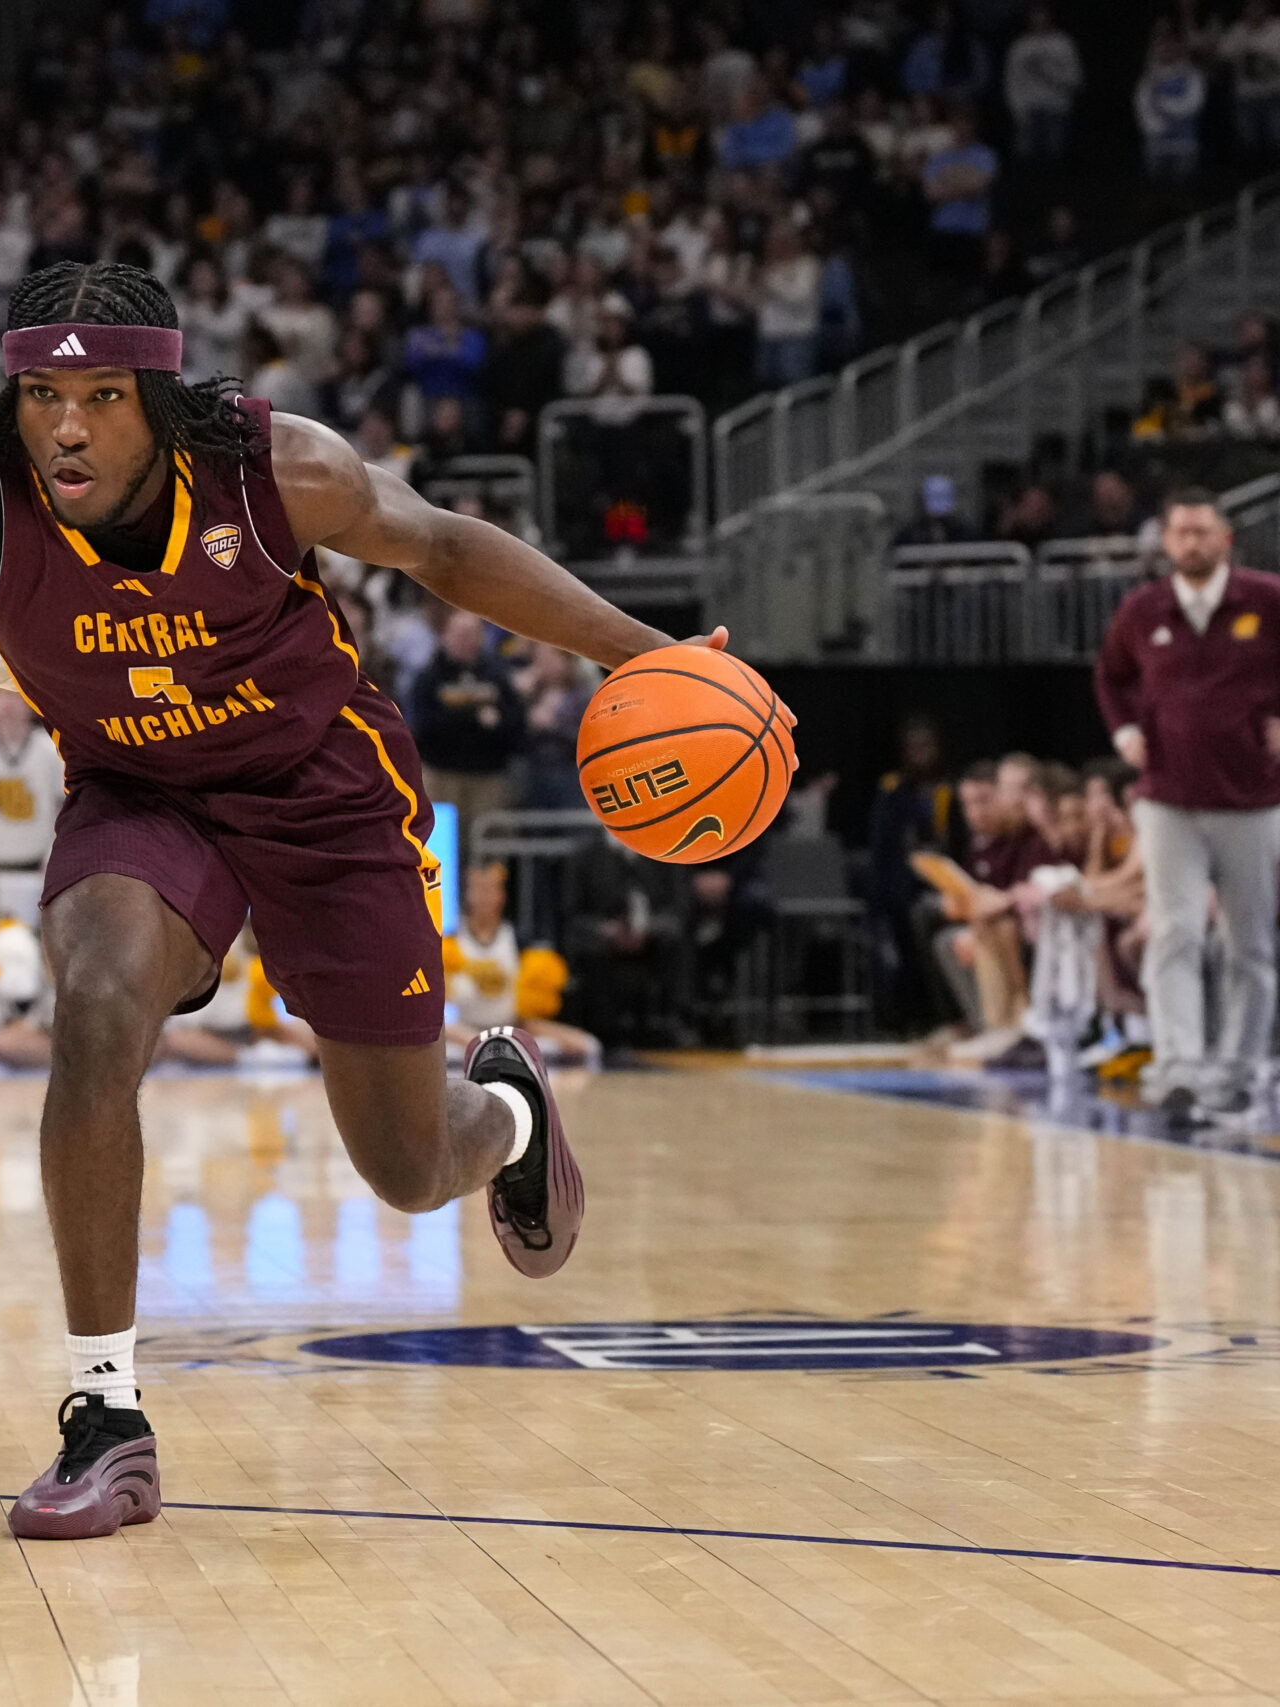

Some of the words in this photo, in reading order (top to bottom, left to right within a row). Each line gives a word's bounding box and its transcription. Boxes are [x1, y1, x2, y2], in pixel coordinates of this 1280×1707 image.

[206, 536, 239, 555] MAC
[73, 610, 218, 657] CENTRAL
[128, 666, 192, 705] 5
[95, 677, 276, 747] MICHIGAN
[591, 758, 691, 815] ELITE
